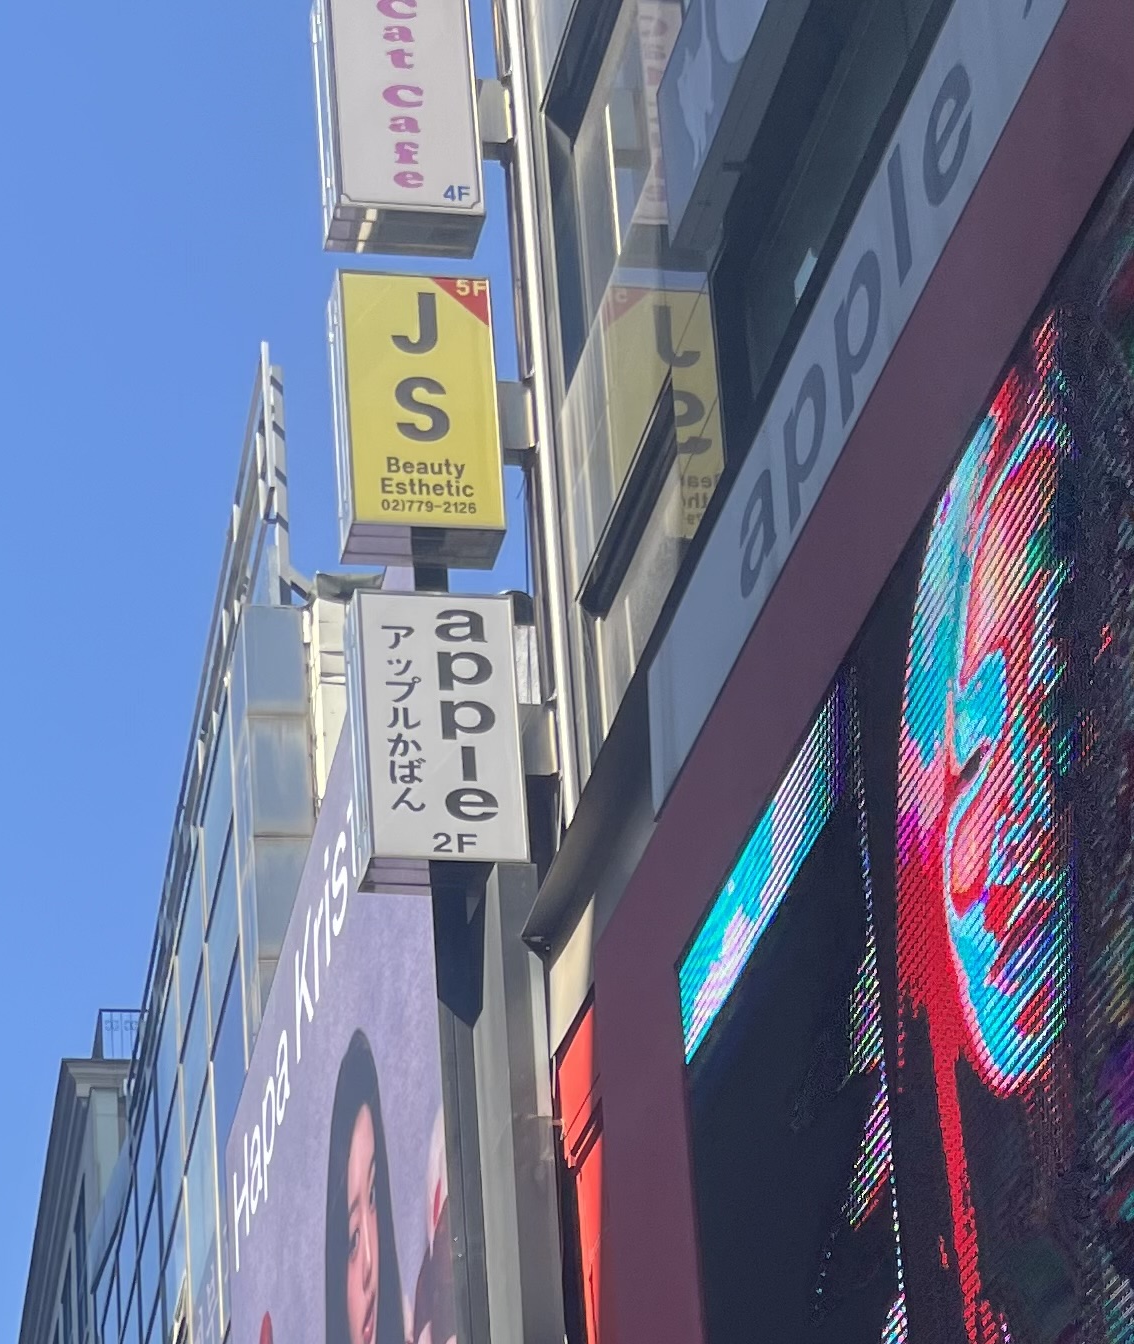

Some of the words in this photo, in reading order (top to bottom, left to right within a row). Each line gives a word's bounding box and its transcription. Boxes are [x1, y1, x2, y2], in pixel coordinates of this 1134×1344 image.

[382, 84, 424, 189] Cafe
[443, 185, 471, 202] 4F
[456, 280, 487, 297] 5F
[738, 62, 974, 600] apple
[386, 457, 465, 480] Beauty
[381, 478, 475, 498] Esthetic
[381, 500, 477, 515] 02)779-2126
[381, 624, 426, 813] アップルかばん
[434, 609, 498, 822] apple
[432, 833, 477, 853] 2F
[233, 1029, 291, 1272] Hapa
